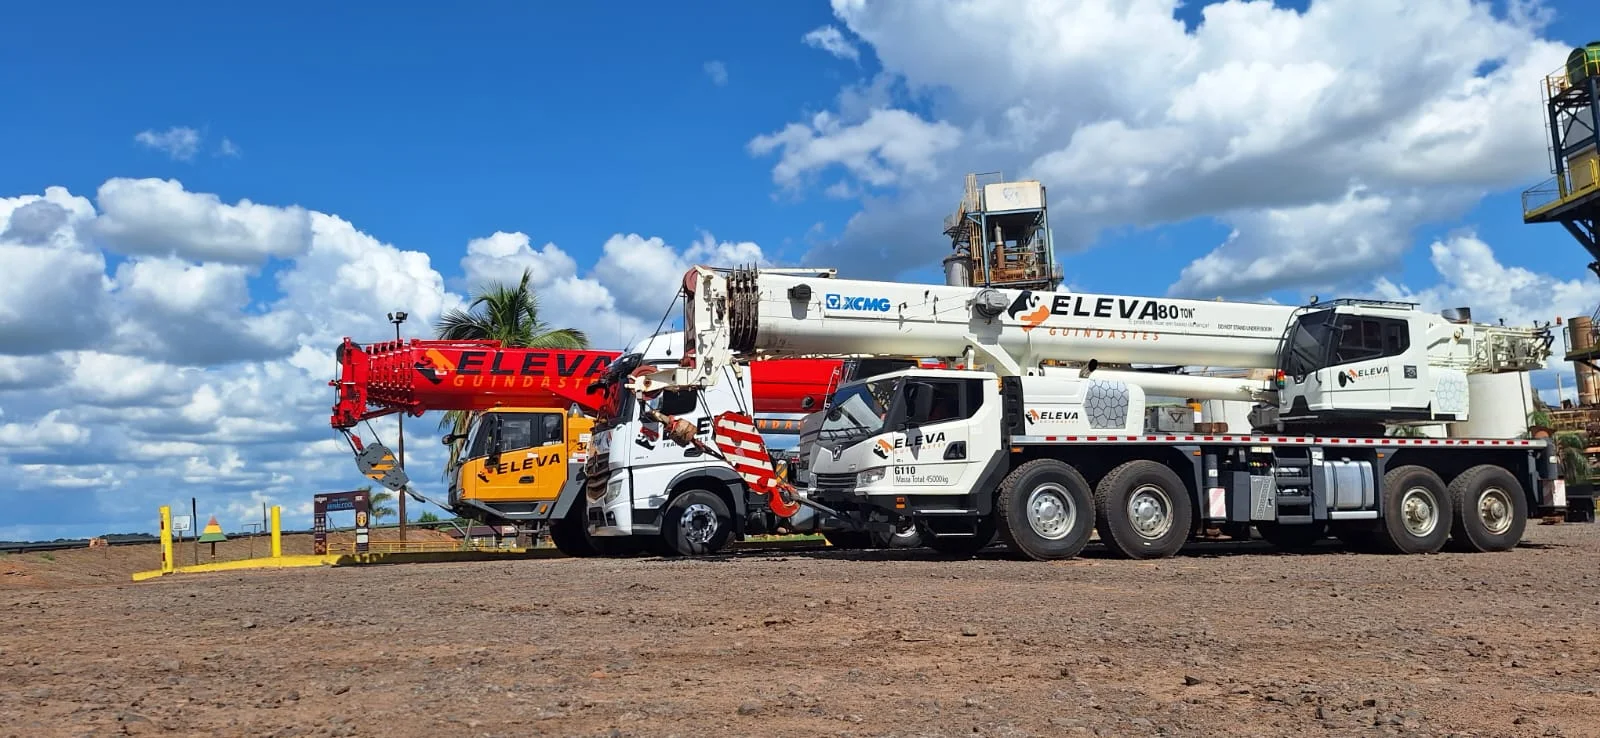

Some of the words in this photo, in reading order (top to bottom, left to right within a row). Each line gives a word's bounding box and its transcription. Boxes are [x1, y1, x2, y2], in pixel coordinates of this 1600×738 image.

[842, 297, 891, 312] XCMG
[1050, 295, 1159, 320] ELEVA
[1158, 304, 1179, 319] 80
[1049, 326, 1160, 341] GUINDASTES
[455, 350, 612, 378] ELEVA
[1358, 366, 1389, 377] ELEVA
[1040, 411, 1079, 420] ELEVA
[894, 432, 946, 449] ELEVA
[497, 453, 561, 475] ELEVA
